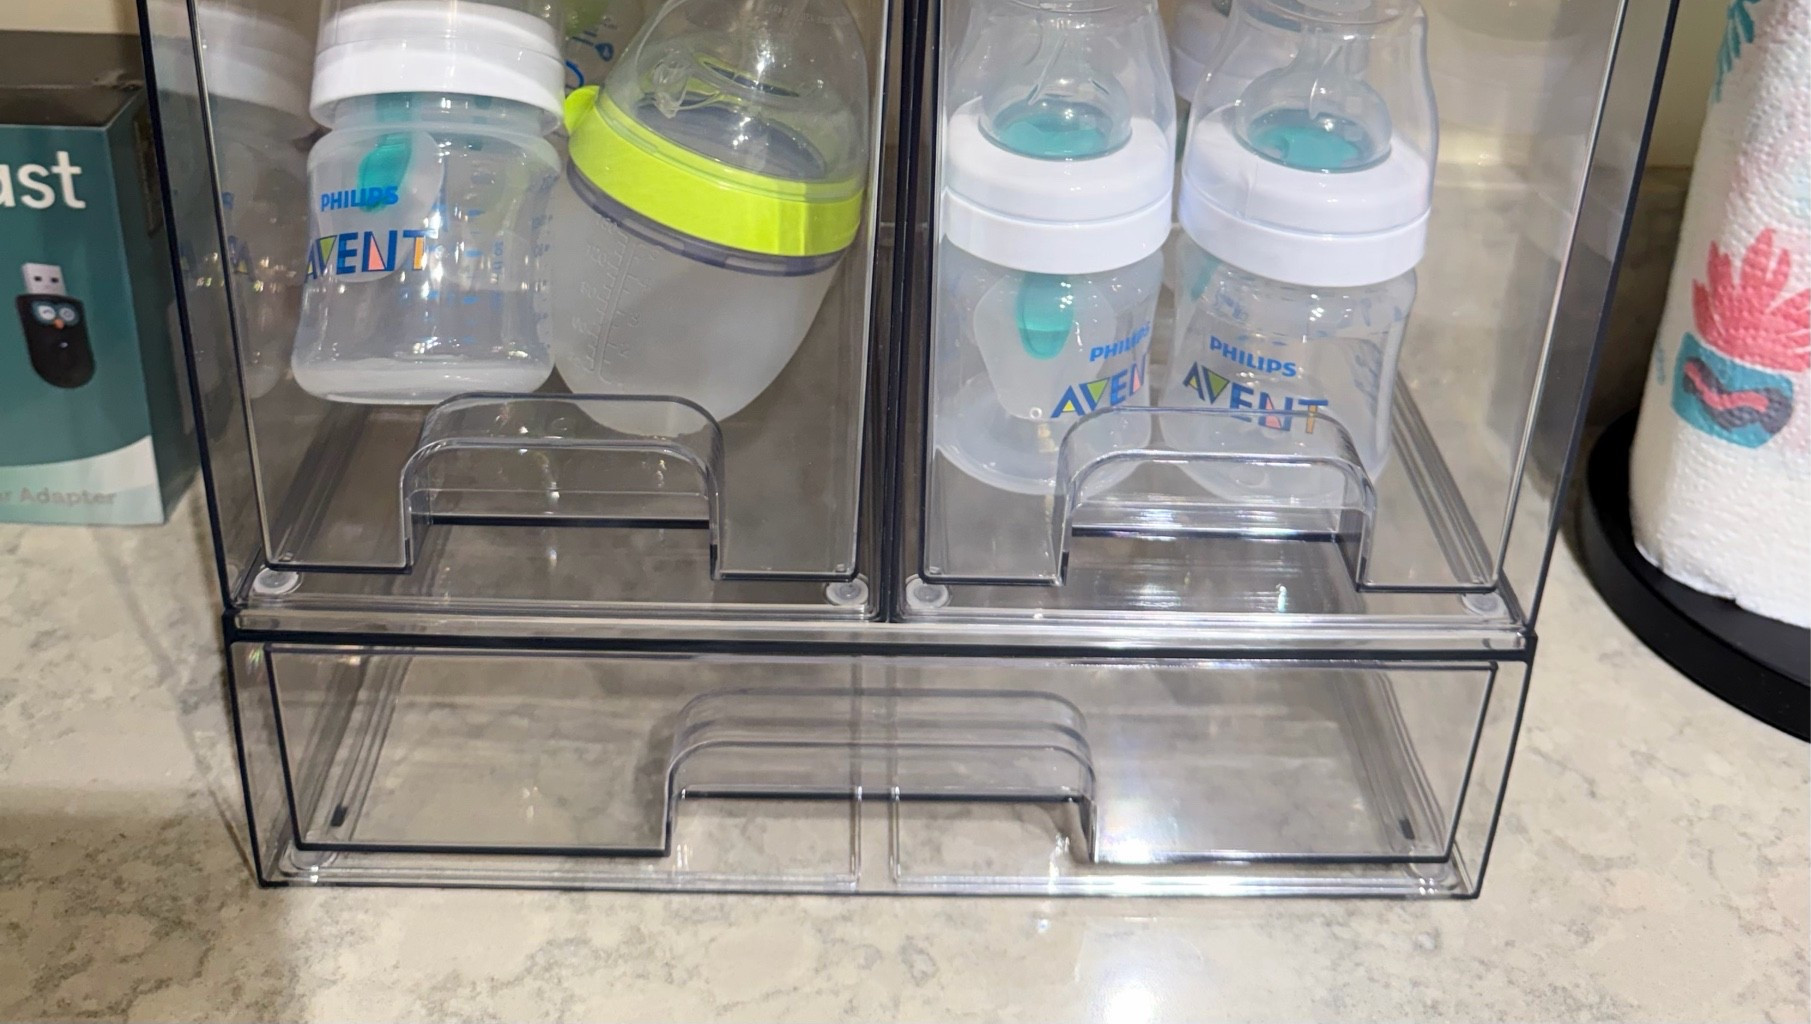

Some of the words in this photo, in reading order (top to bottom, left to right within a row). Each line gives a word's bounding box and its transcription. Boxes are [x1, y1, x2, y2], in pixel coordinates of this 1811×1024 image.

[320, 186, 399, 212] PHILIPS
[305, 229, 438, 280] AVENT
[1210, 335, 1297, 377] PHILIPS
[1183, 362, 1328, 434] AVENT
[20, 487, 117, 507] Adapter
